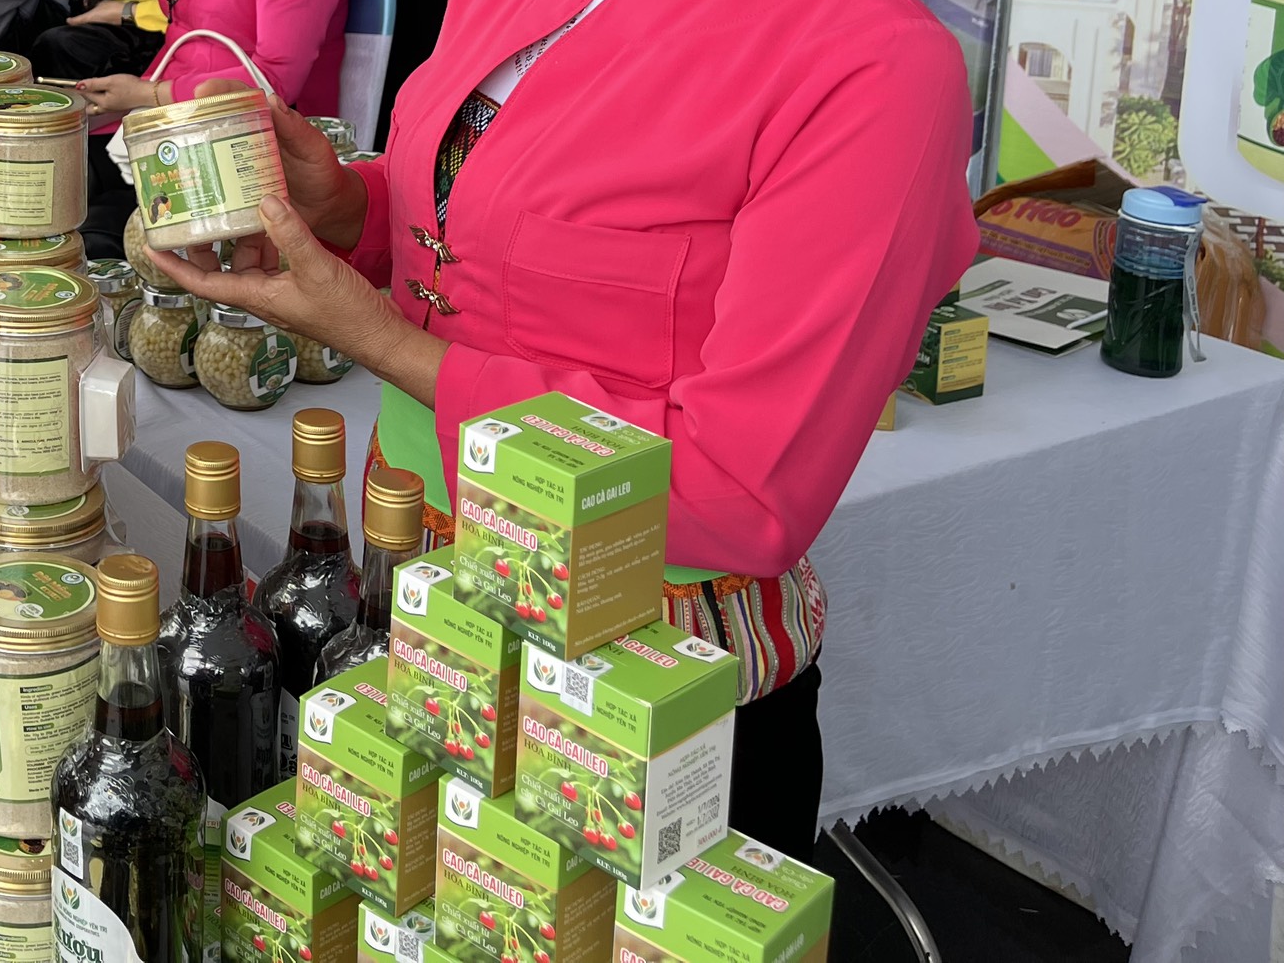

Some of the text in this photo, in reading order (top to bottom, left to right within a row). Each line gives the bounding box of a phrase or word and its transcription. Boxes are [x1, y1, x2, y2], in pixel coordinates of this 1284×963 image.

[534, 474, 545, 487] HỢP
[581, 481, 631, 510] CAO CÀ GAI LEO
[461, 498, 538, 551] CAO CÀ GAI LEO
[462, 520, 505, 549] HÒA BÌNH
[460, 555, 505, 587] Chiết xuất từ
[472, 573, 483, 588] Cà
[483, 580, 496, 595] Gai
[497, 588, 512, 603] Leo
[394, 637, 467, 693] CAO CÀ GAI LEO
[624, 639, 678, 669] GAI LEO
[394, 659, 436, 689] HÒA BÌNH
[605, 700, 616, 712] HỢP
[523, 716, 609, 778] CAO CÀ GAI LEO
[524, 738, 572, 772] HÒA BÌNH
[301, 763, 371, 817] CAO CÀ GAI LEO
[302, 783, 342, 813] HÒA BÌNH
[521, 774, 572, 810] Chiết xuất từ
[535, 795, 546, 808] Cà
[547, 802, 562, 817] Gai
[563, 812, 579, 827] Leo
[443, 848, 525, 910] CAO CÀ GAI LEO
[444, 869, 490, 903] HÒA BÌNH
[224, 877, 287, 934] CAO CÀ GAI LEO
